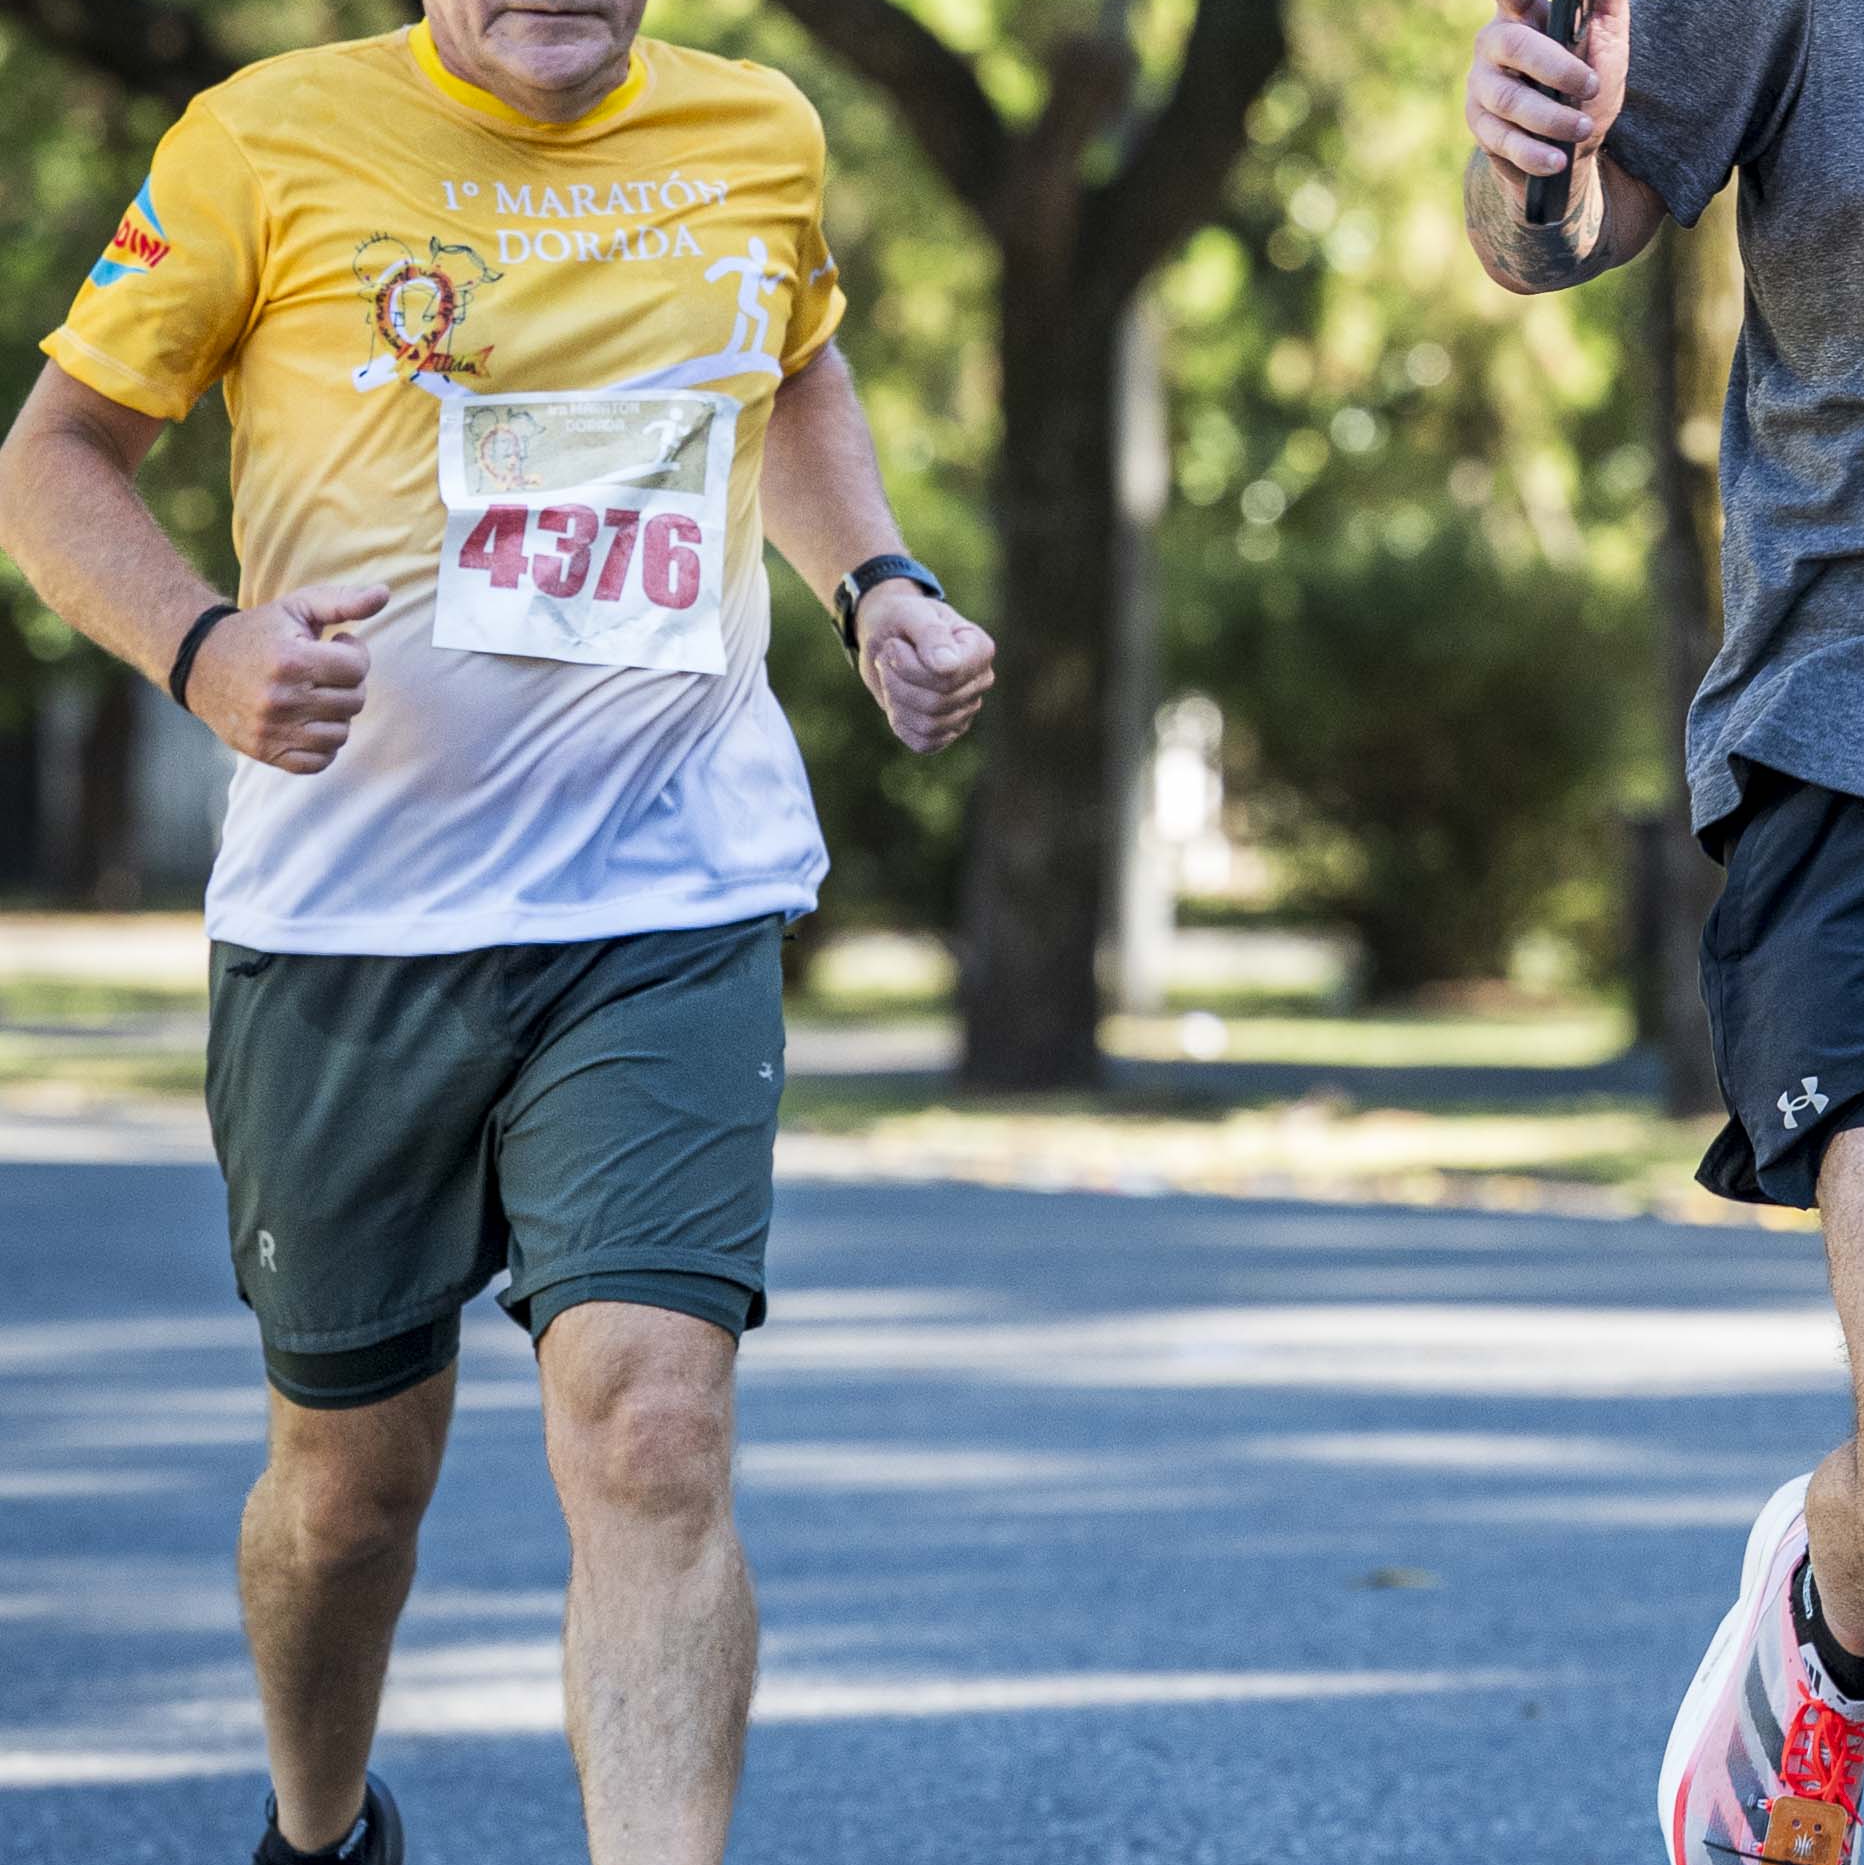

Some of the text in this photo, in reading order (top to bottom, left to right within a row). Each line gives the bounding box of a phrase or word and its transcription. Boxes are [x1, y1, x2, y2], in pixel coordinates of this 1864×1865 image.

[494, 170, 729, 219] MARATÓN
[495, 223, 705, 265] DORADA
[458, 504, 703, 610] 4376
[256, 1229, 278, 1273] R
